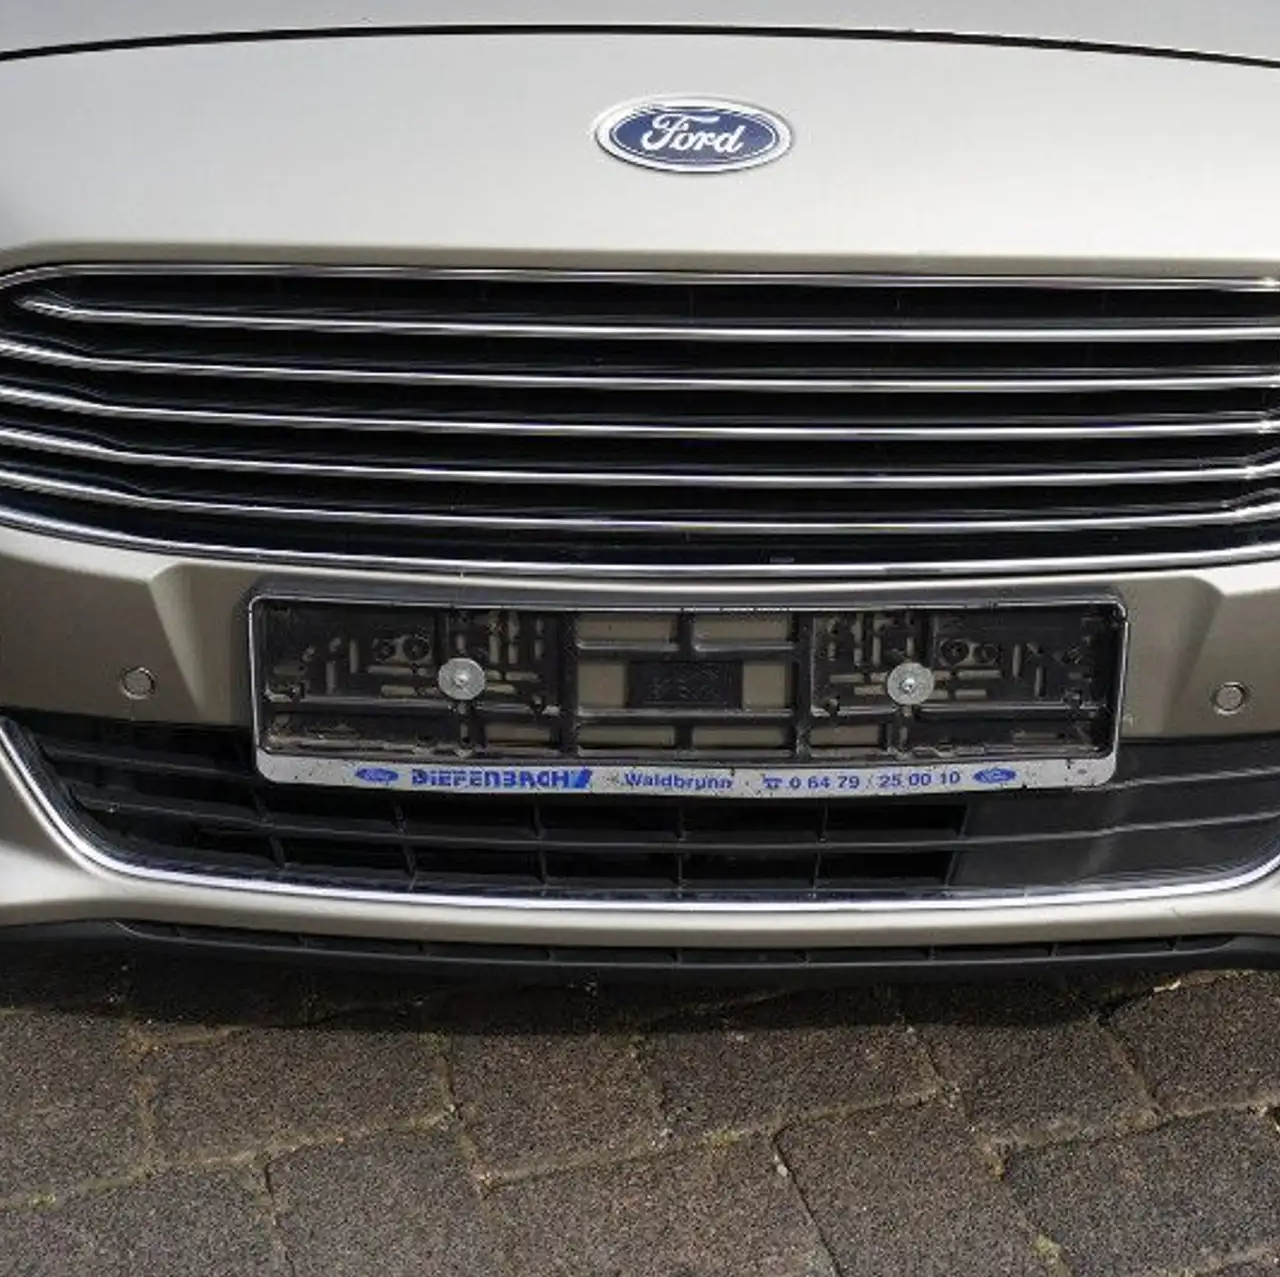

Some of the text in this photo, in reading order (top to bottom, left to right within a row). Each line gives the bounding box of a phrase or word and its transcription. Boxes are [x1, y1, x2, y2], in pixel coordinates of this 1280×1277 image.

[640, 112, 745, 154] Ford
[623, 771, 733, 791] Waldbrunn
[807, 776, 830, 790] 64
[837, 774, 860, 789] 79
[879, 773, 902, 788] 25
[908, 772, 932, 786] 00
[940, 771, 961, 785] 10
